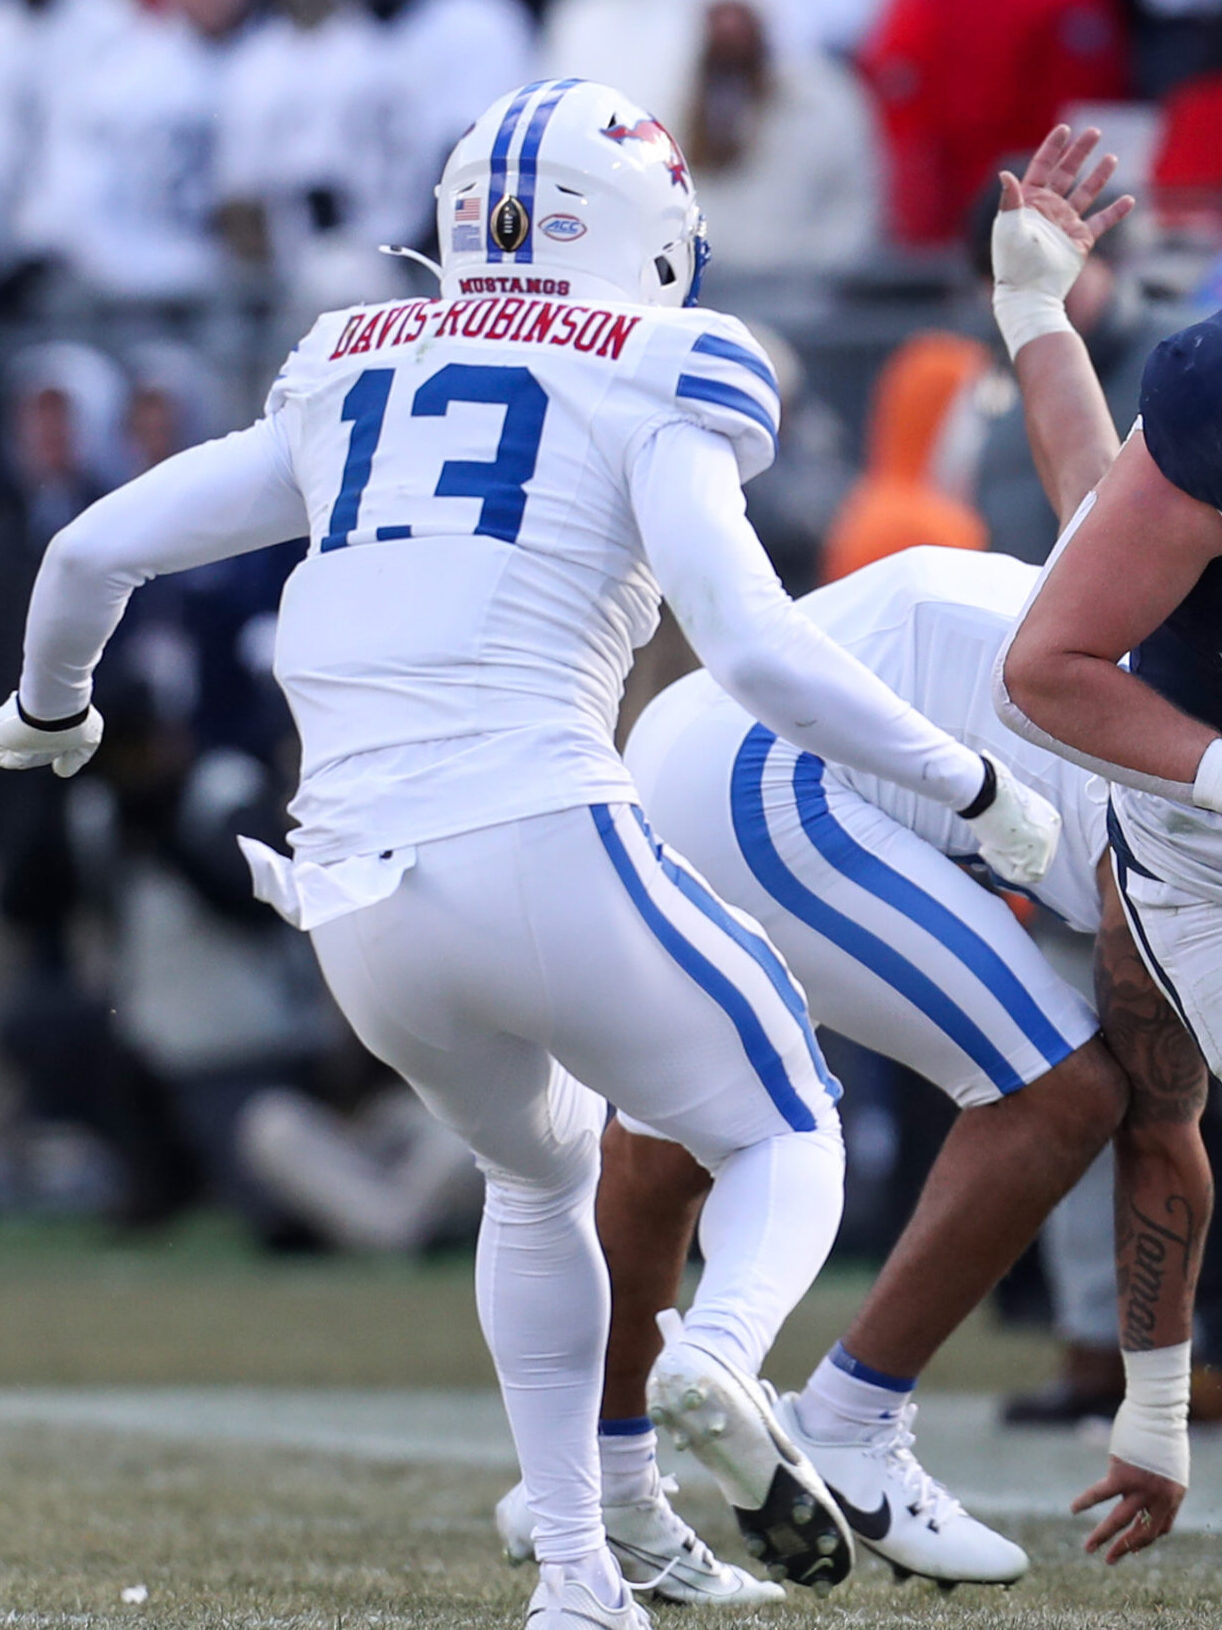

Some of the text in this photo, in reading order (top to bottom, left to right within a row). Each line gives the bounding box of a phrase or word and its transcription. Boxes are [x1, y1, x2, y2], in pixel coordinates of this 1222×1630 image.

[543, 219, 579, 235] ACC
[458, 277, 571, 296] MUSTANGS
[328, 297, 642, 361] DAVIS-ROBINSON
[320, 363, 550, 554] 13
